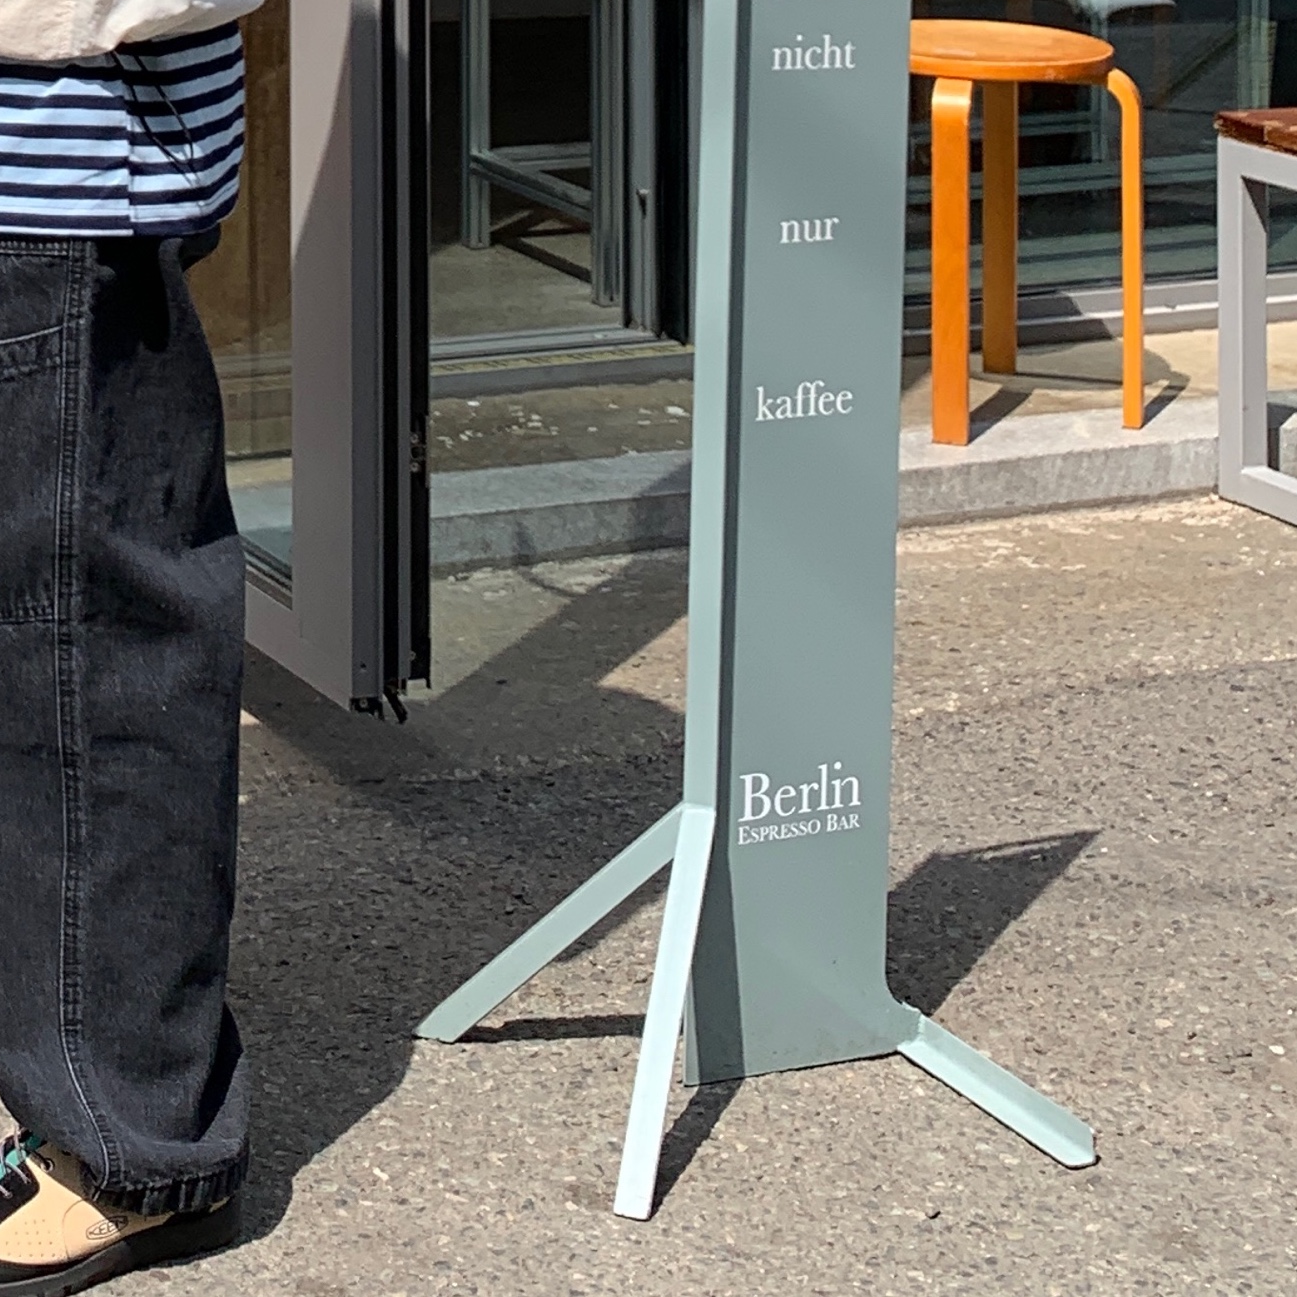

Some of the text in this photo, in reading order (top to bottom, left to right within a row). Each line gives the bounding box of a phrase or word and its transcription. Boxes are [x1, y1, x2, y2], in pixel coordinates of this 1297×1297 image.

[772, 33, 856, 71] nicht
[779, 216, 840, 244] nur
[755, 380, 853, 422] kaffee
[737, 761, 862, 822] Berlin
[737, 813, 861, 845] ESPRESSO BAR
